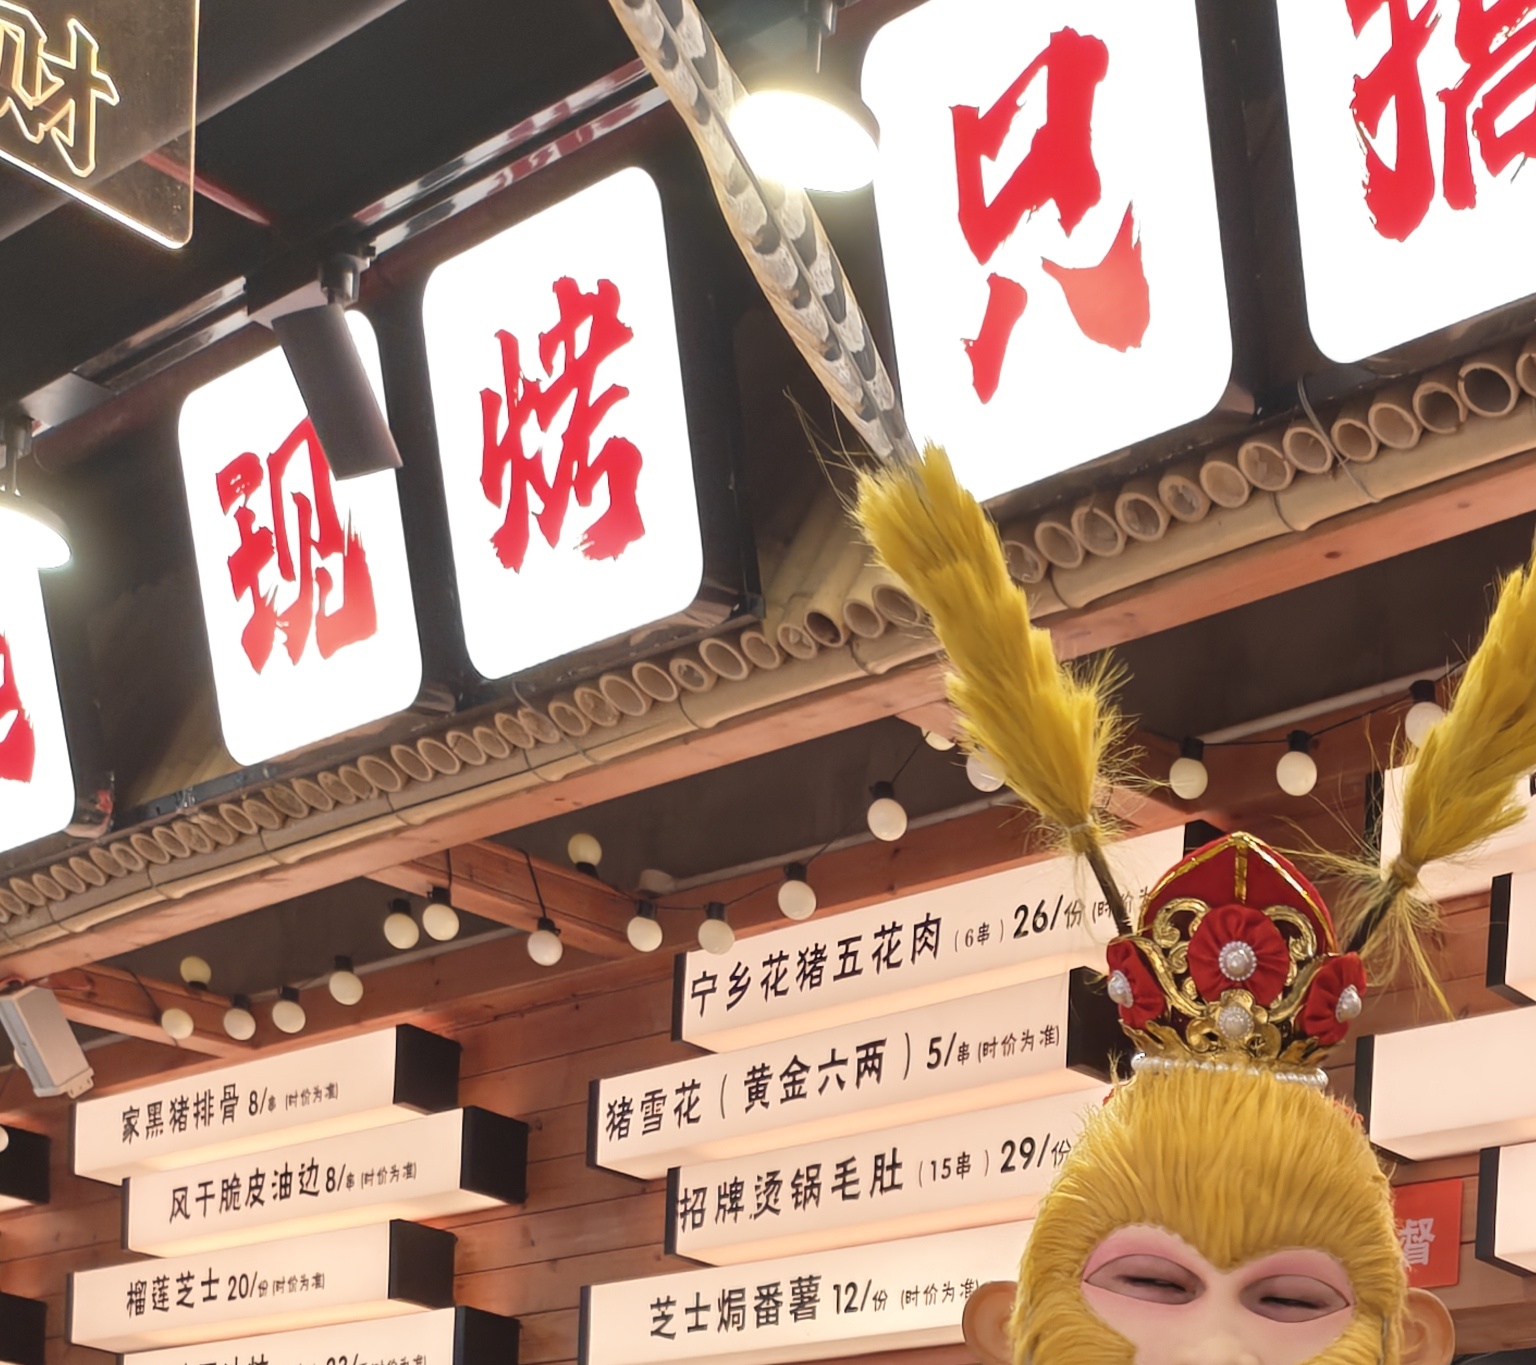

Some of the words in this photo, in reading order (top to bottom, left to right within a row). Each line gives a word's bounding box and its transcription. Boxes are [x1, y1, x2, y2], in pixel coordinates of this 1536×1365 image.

[479, 276, 645, 573] 烤
[690, 911, 943, 1017] 宁乡花猪五花肉
[121, 1083, 239, 1144] 家黑猪排骨
[169, 1156, 322, 1225] 风干脆皮油边
[678, 1146, 905, 1233] 招牌烫锅毛肚
[126, 1267, 221, 1319] 榴莲芝士
[649, 1274, 822, 1341] 芝士焗番薯
